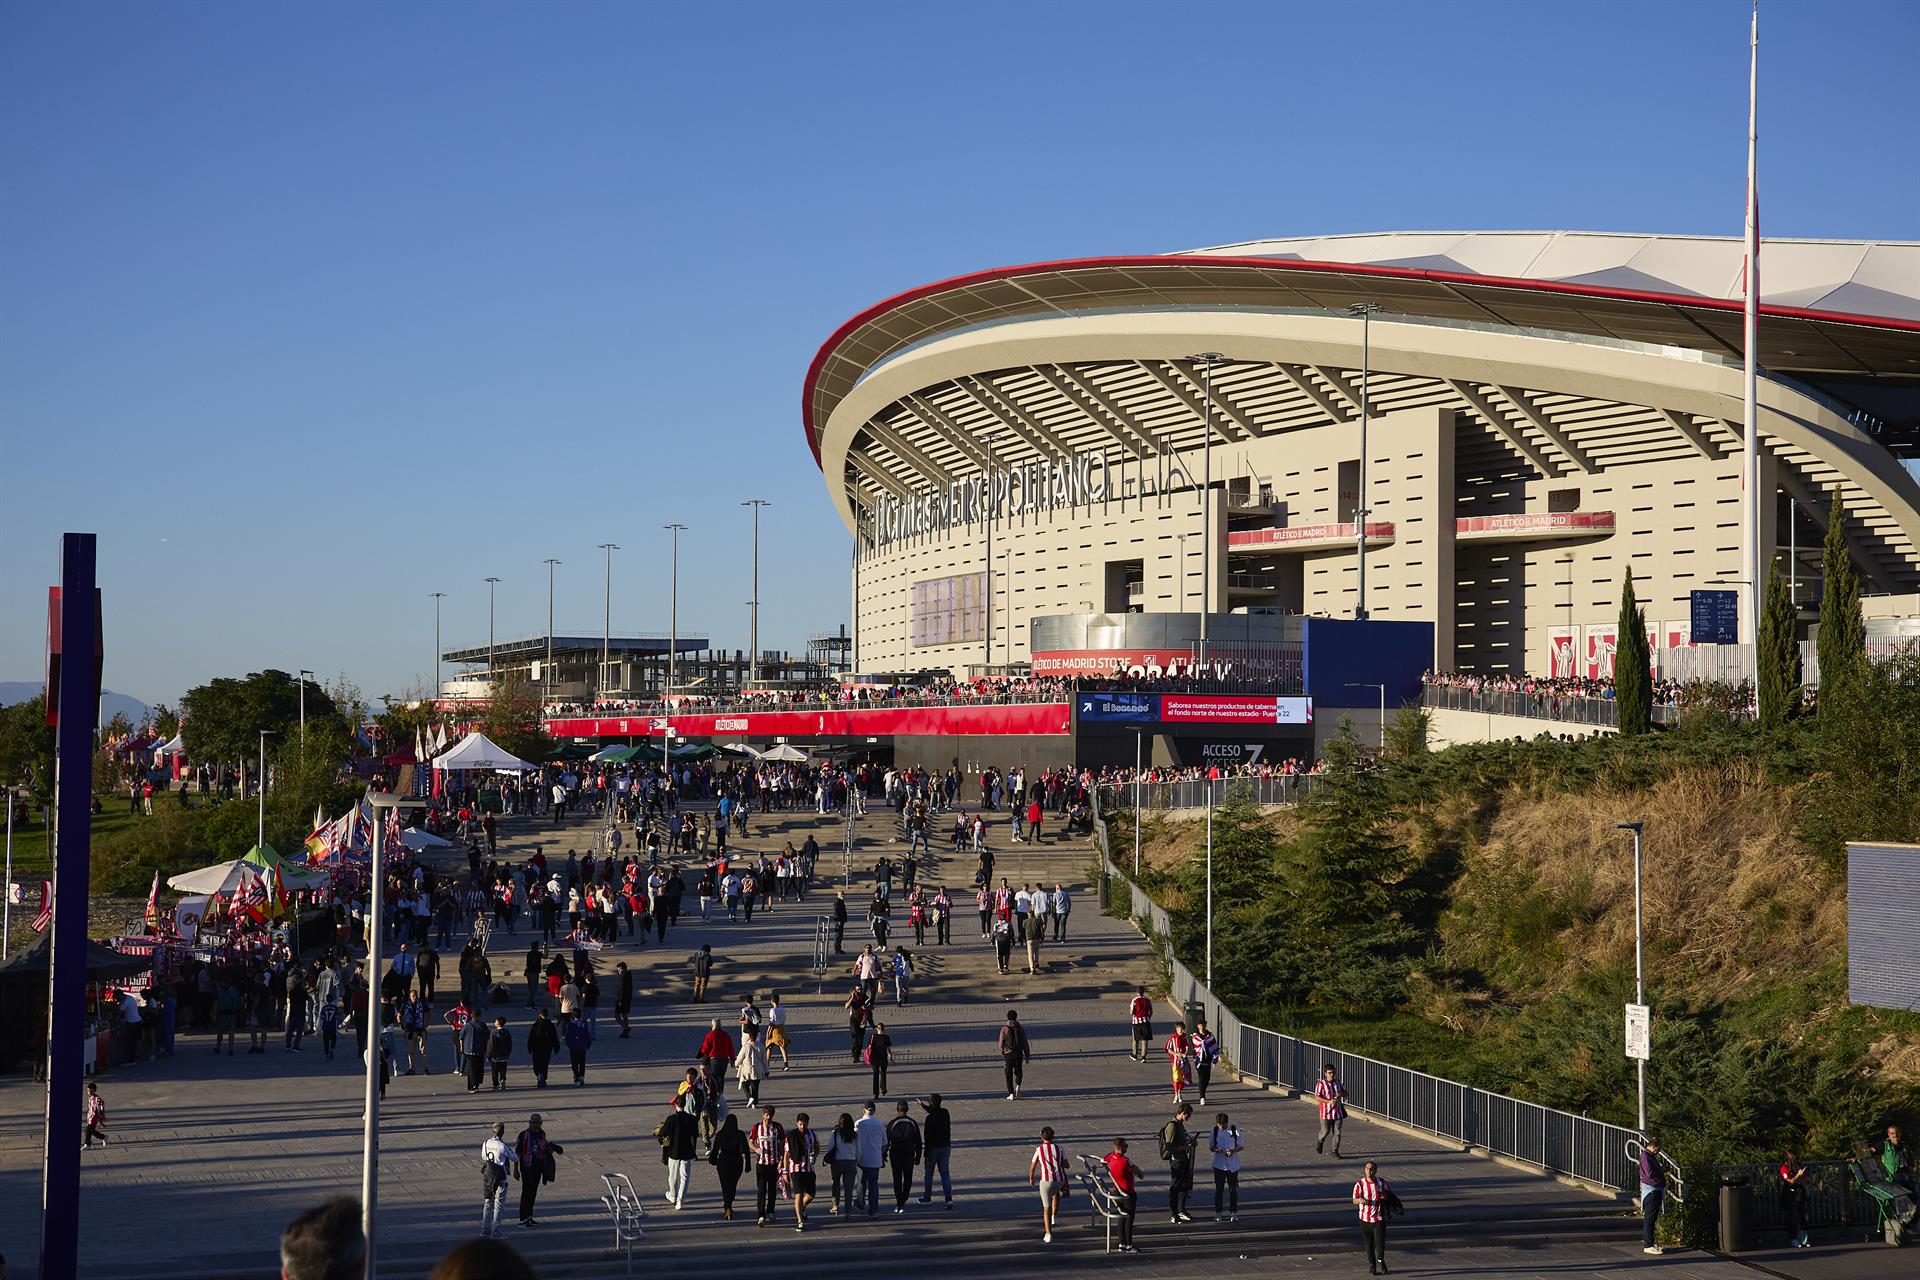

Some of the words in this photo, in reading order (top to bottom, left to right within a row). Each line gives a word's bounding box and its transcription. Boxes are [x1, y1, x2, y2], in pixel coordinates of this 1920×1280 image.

[1532, 516, 1566, 527] MADRID
[1052, 658, 1061, 669] DE
[1062, 657, 1096, 669] MADRID
[1202, 744, 1241, 757] ACCESO
[325, 1010, 335, 1021] 17
